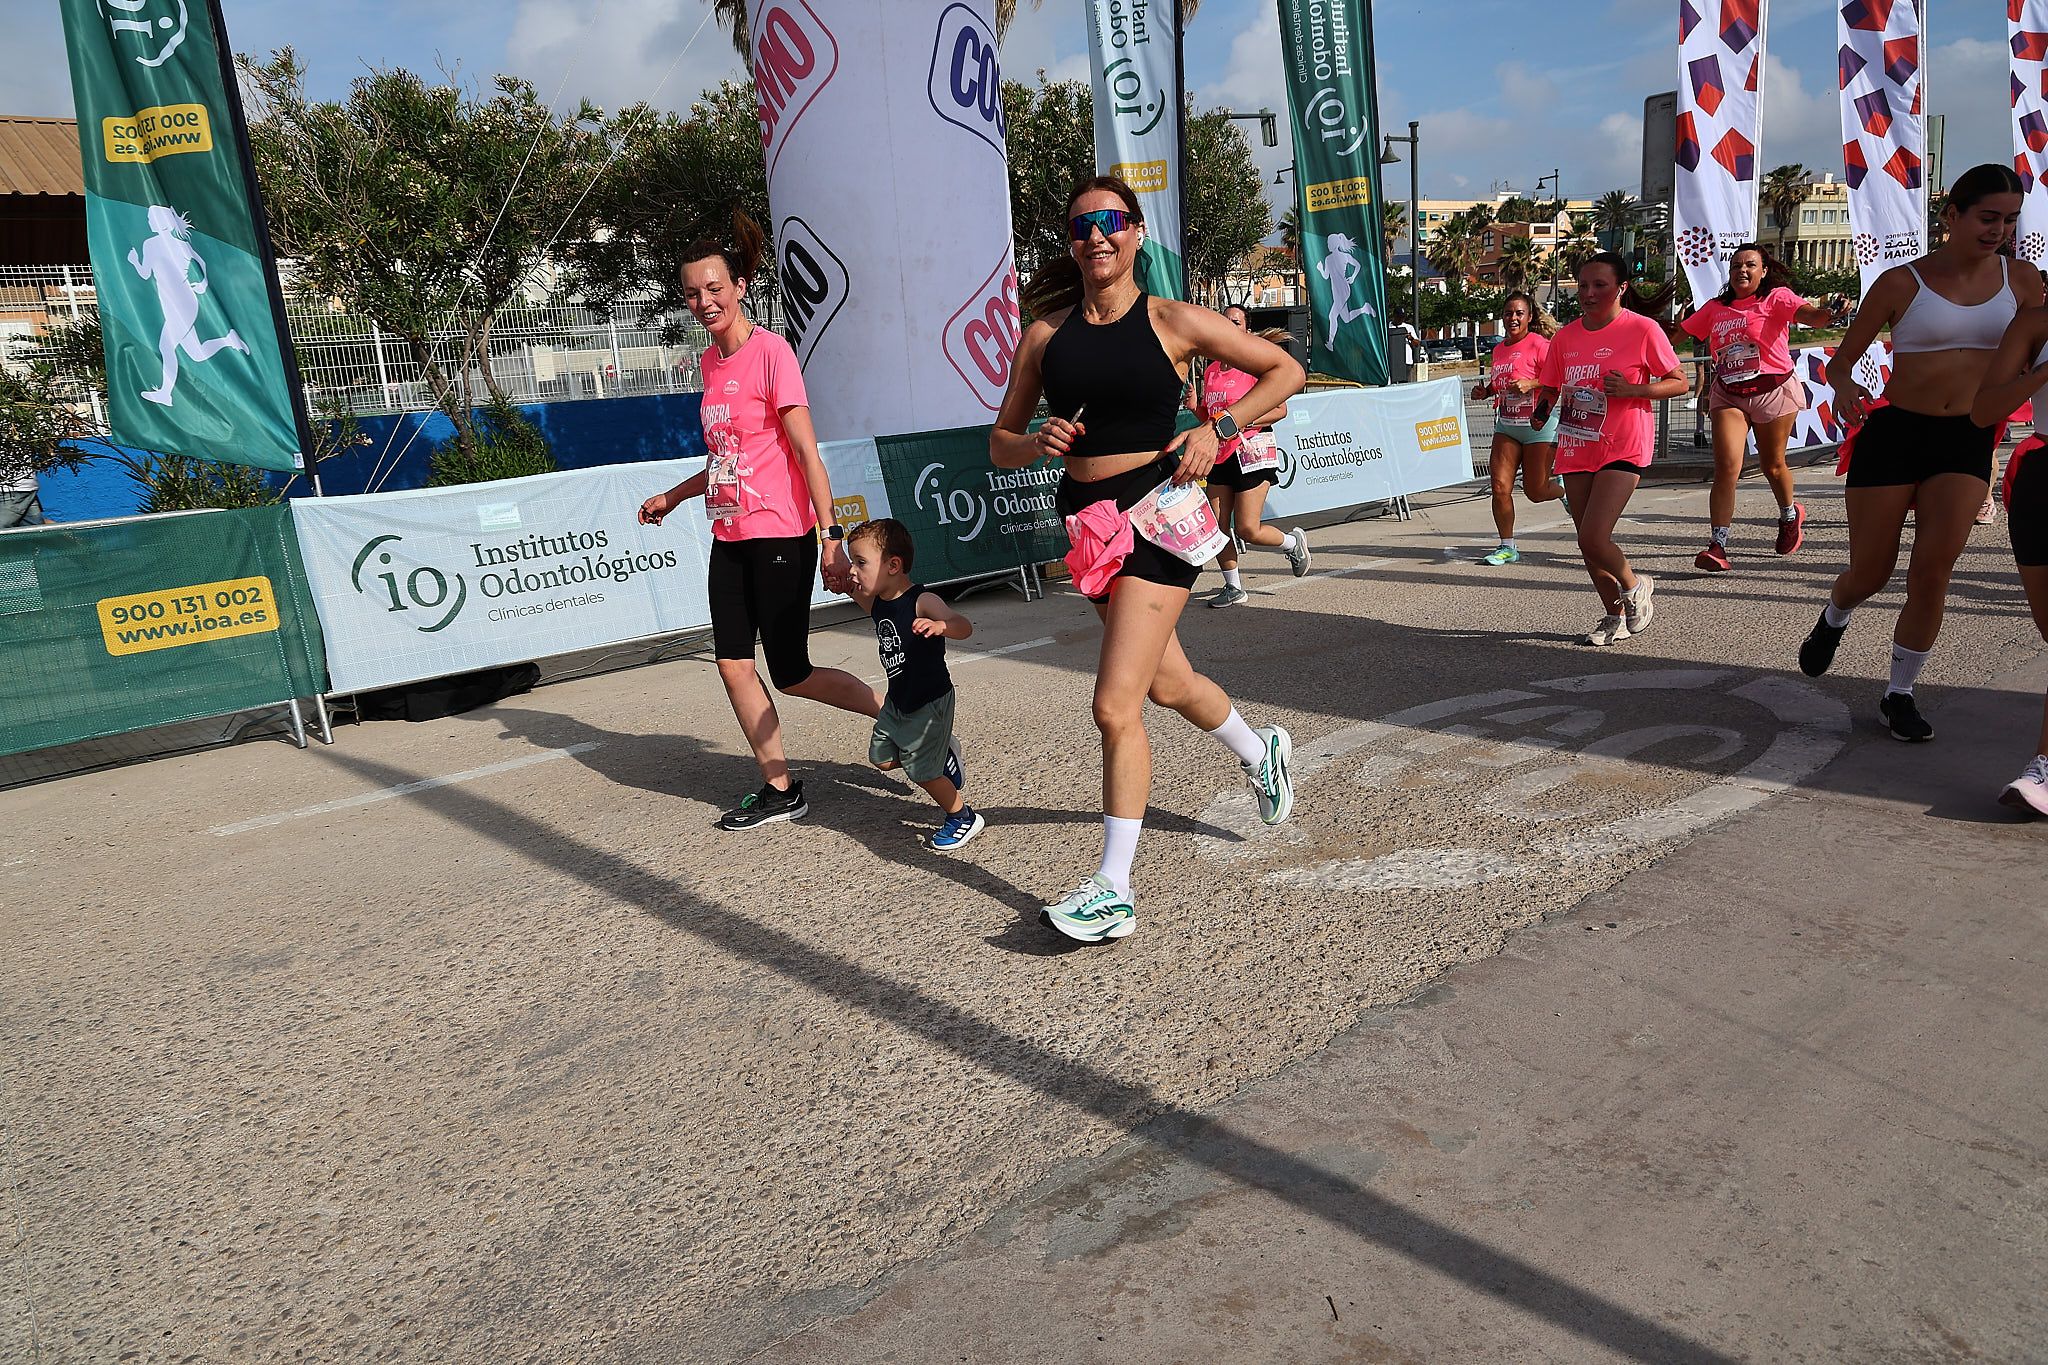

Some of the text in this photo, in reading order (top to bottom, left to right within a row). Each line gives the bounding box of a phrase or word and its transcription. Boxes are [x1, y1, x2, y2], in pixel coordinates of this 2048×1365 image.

[1727, 360, 1744, 368] 016
[1572, 410, 1588, 420] 016
[1294, 431, 1352, 450] Institutos
[1300, 446, 1382, 471] Odontológicos
[1329, 471, 1354, 482] dentales
[1000, 522, 1033, 536] Clínicas
[1176, 508, 1206, 536] 016
[470, 529, 608, 567] Institutos
[479, 549, 678, 599] Odontológicos
[111, 587, 263, 624] 900 131 002
[488, 591, 605, 623] Clínicas dentales
[117, 609, 267, 644] www.ioa.es
